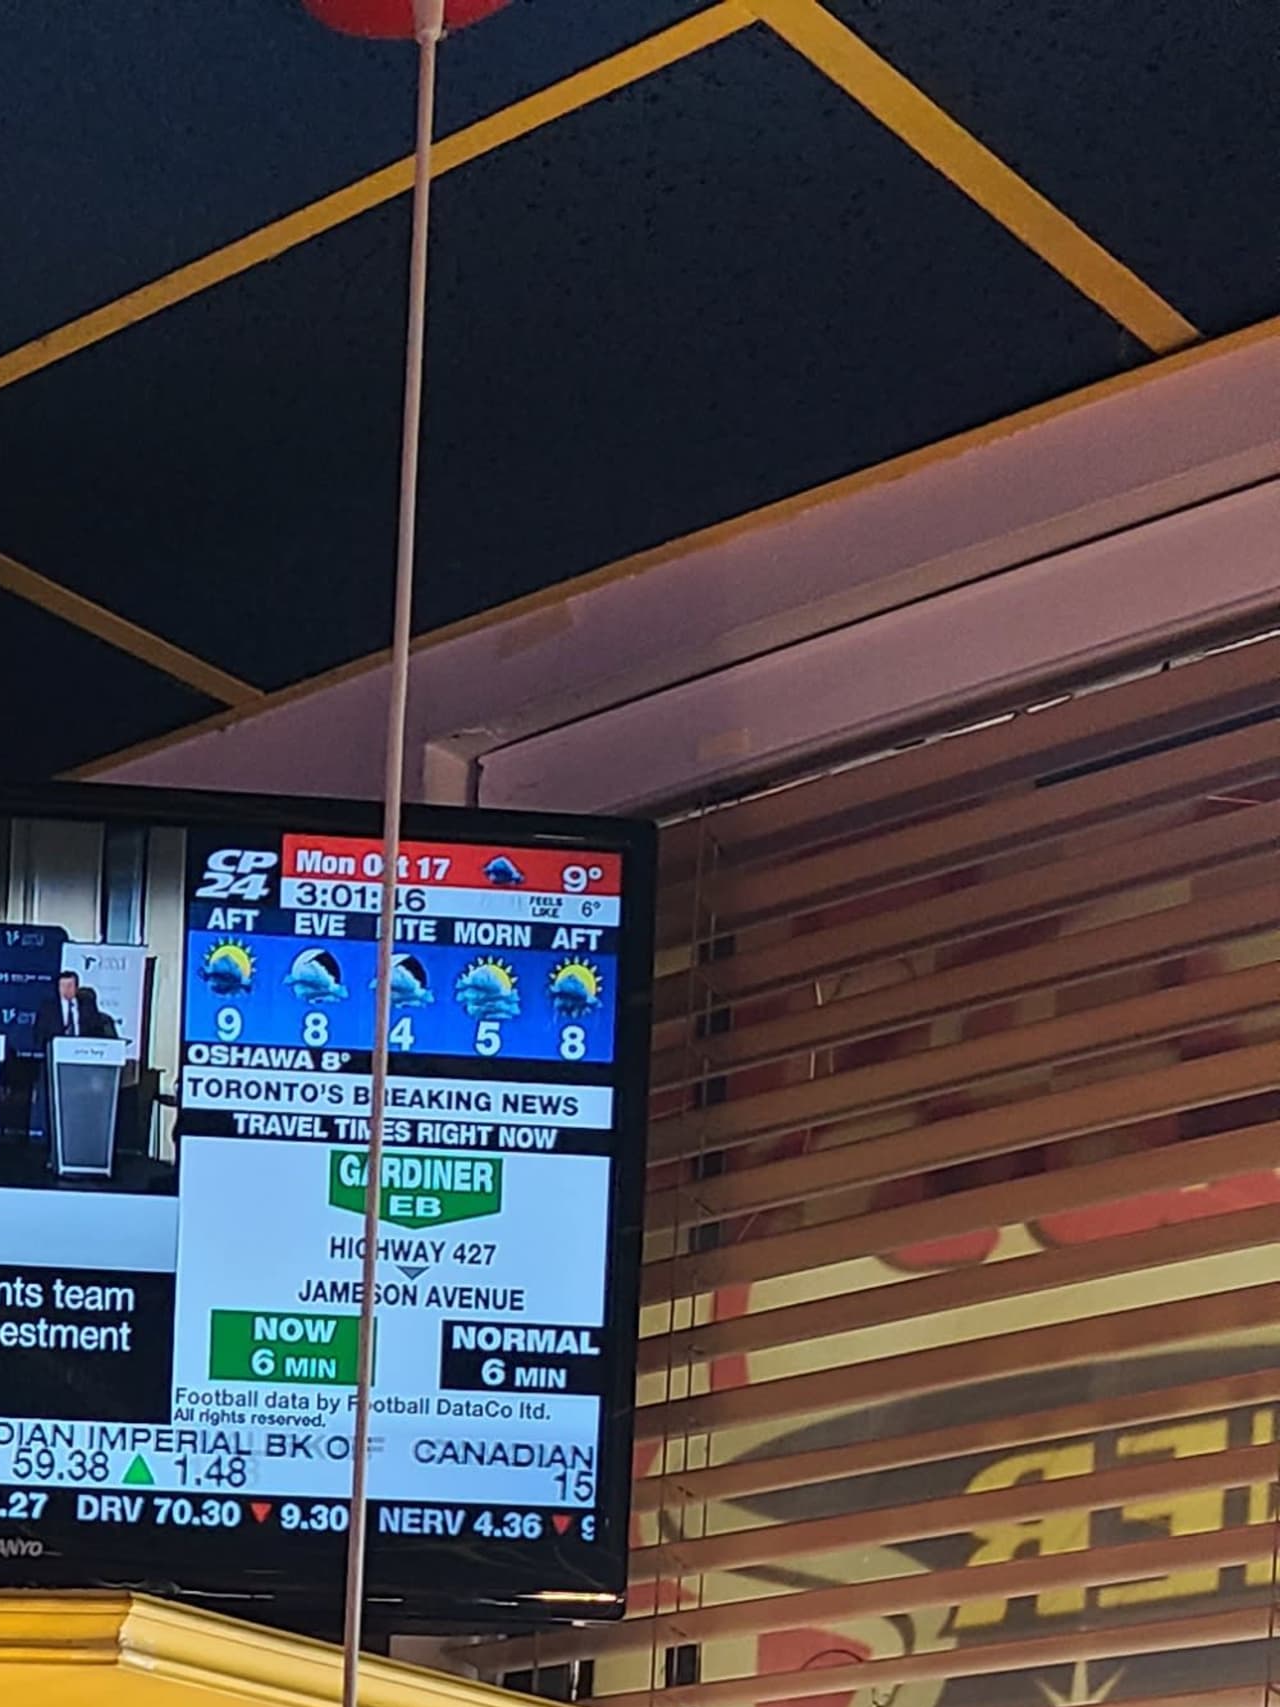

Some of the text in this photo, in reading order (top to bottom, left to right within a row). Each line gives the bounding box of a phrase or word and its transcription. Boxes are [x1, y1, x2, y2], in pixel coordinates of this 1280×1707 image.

[296, 849, 451, 881] Mon 17
[294, 912, 603, 952] EVE MORN AFT
[187, 1043, 313, 1071] OSHAWA
[501, 1092, 579, 1116] NEWS
[233, 1112, 493, 1147] TRAVEL RIGHT
[452, 1241, 497, 1266] 427
[53, 1279, 135, 1312] team
[425, 1285, 525, 1311] AVENUE
[253, 1316, 337, 1344] NOW
[452, 1325, 600, 1356] NORMAL
[285, 1355, 337, 1379] MIN
[514, 1366, 567, 1389] MIN
[175, 1387, 513, 1420] Football by DataCo
[88, 1427, 251, 1457] IMPERIAL
[265, 1433, 314, 1459] BK
[413, 1438, 594, 1470] CANADIAN
[12, 1448, 110, 1481] 59.38
[174, 1456, 247, 1487] 1.48
[153, 1497, 241, 1527] 70.30
[378, 1506, 465, 1536] NERV
[473, 1512, 543, 1540] 4.36
